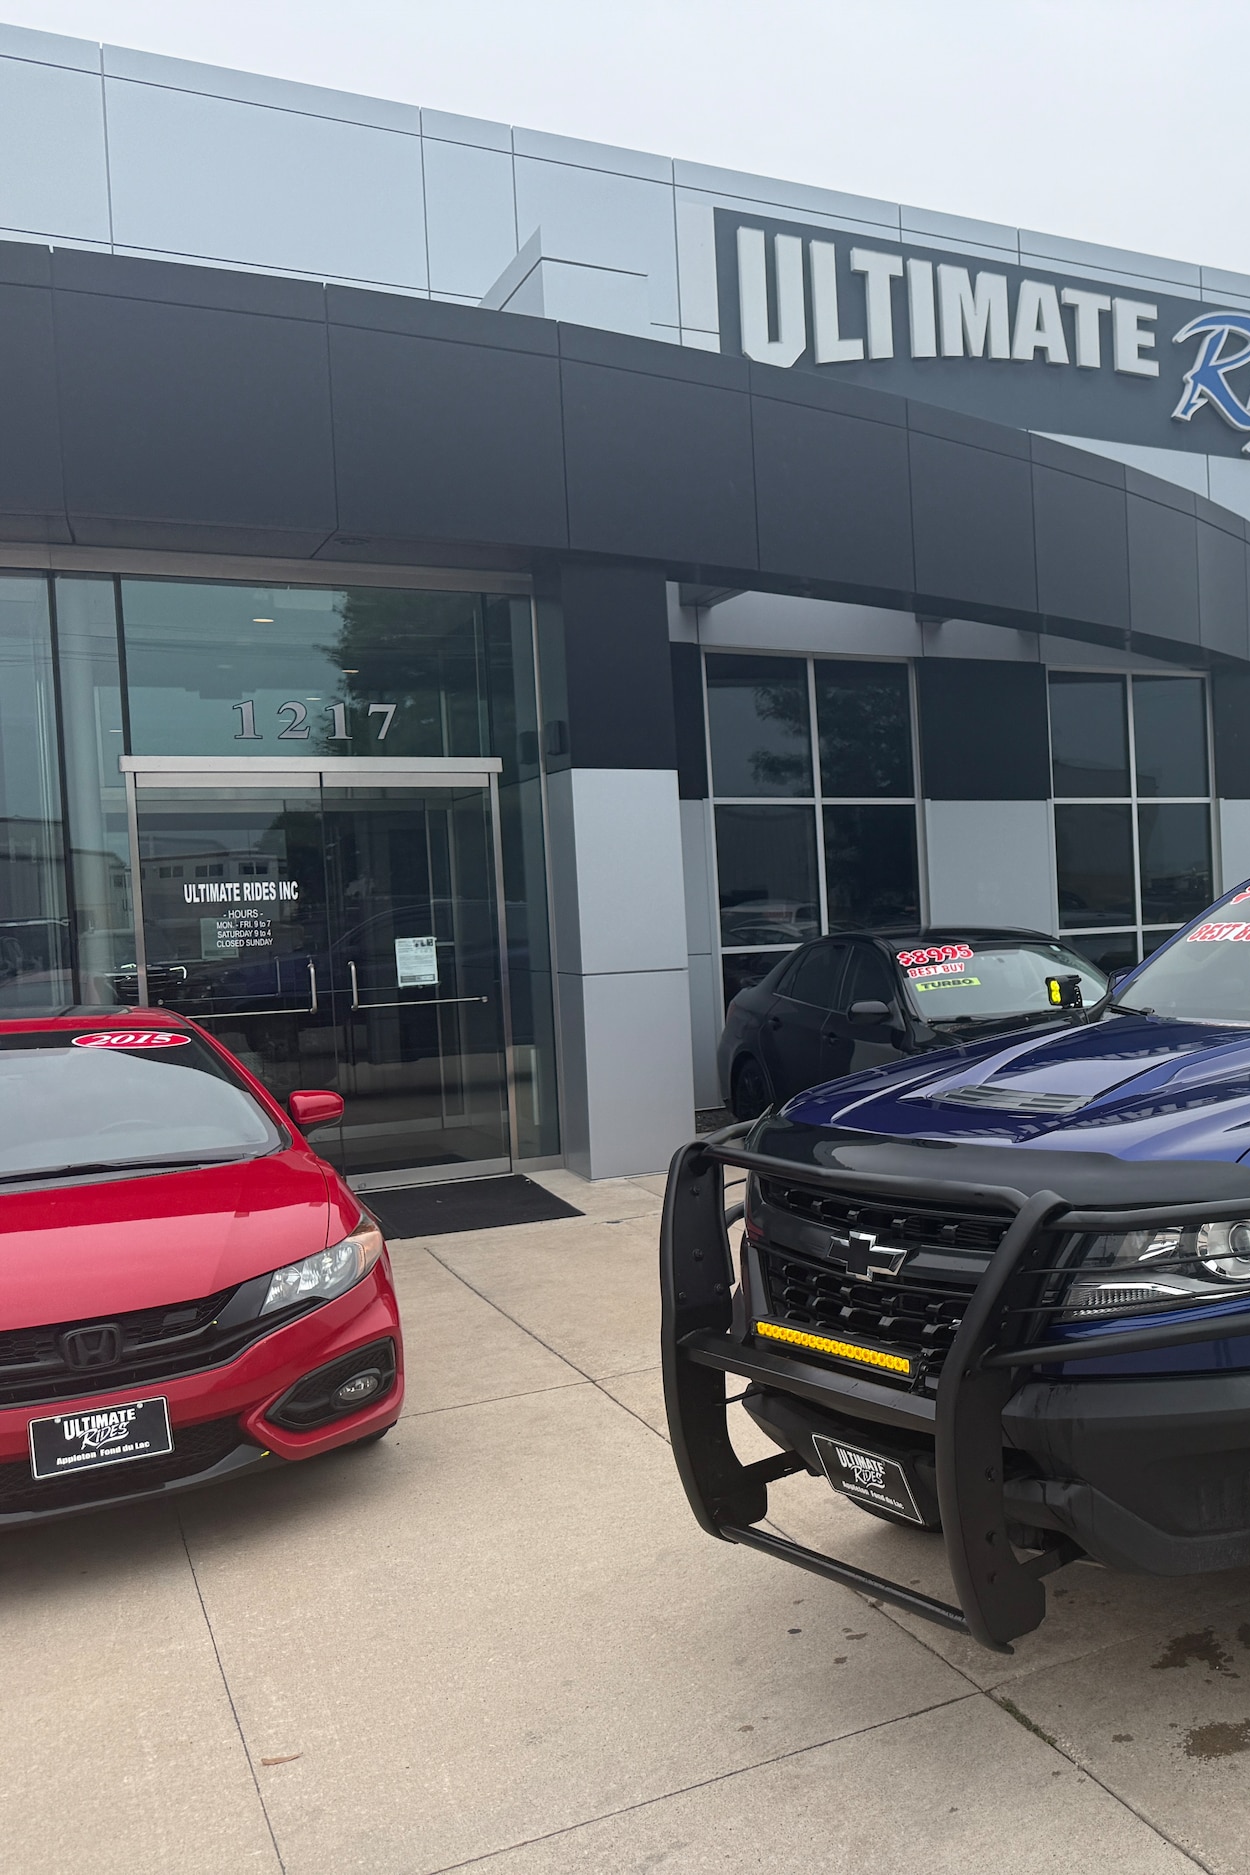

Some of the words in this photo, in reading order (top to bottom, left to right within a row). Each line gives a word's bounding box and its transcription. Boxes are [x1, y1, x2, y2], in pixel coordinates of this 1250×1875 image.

[736, 225, 1160, 378] ULTIMATE
[232, 700, 397, 740] 1217
[183, 883, 241, 903] ULTIMATE
[243, 881, 277, 901] RIDES
[279, 880, 299, 900] INC
[228, 909, 259, 919] HOURS
[260, 920, 266, 928] to
[1187, 923, 1237, 942] BEST
[216, 940, 245, 948] CLOSED
[246, 938, 274, 947] SUNDAY
[217, 930, 253, 939] SATURDAY
[897, 944, 973, 966] $8995
[907, 965, 940, 978] BEST
[940, 962, 965, 975] BUY
[920, 978, 974, 990] TURBO
[85, 1034, 175, 1046] 2015
[63, 1408, 137, 1440] ULTIMATE
[56, 1451, 97, 1465] Appleton
[100, 1446, 121, 1457] Fond
[122, 1443, 134, 1452] du
[135, 1440, 150, 1450] Lac
[835, 1446, 885, 1475] ULTIMATE
